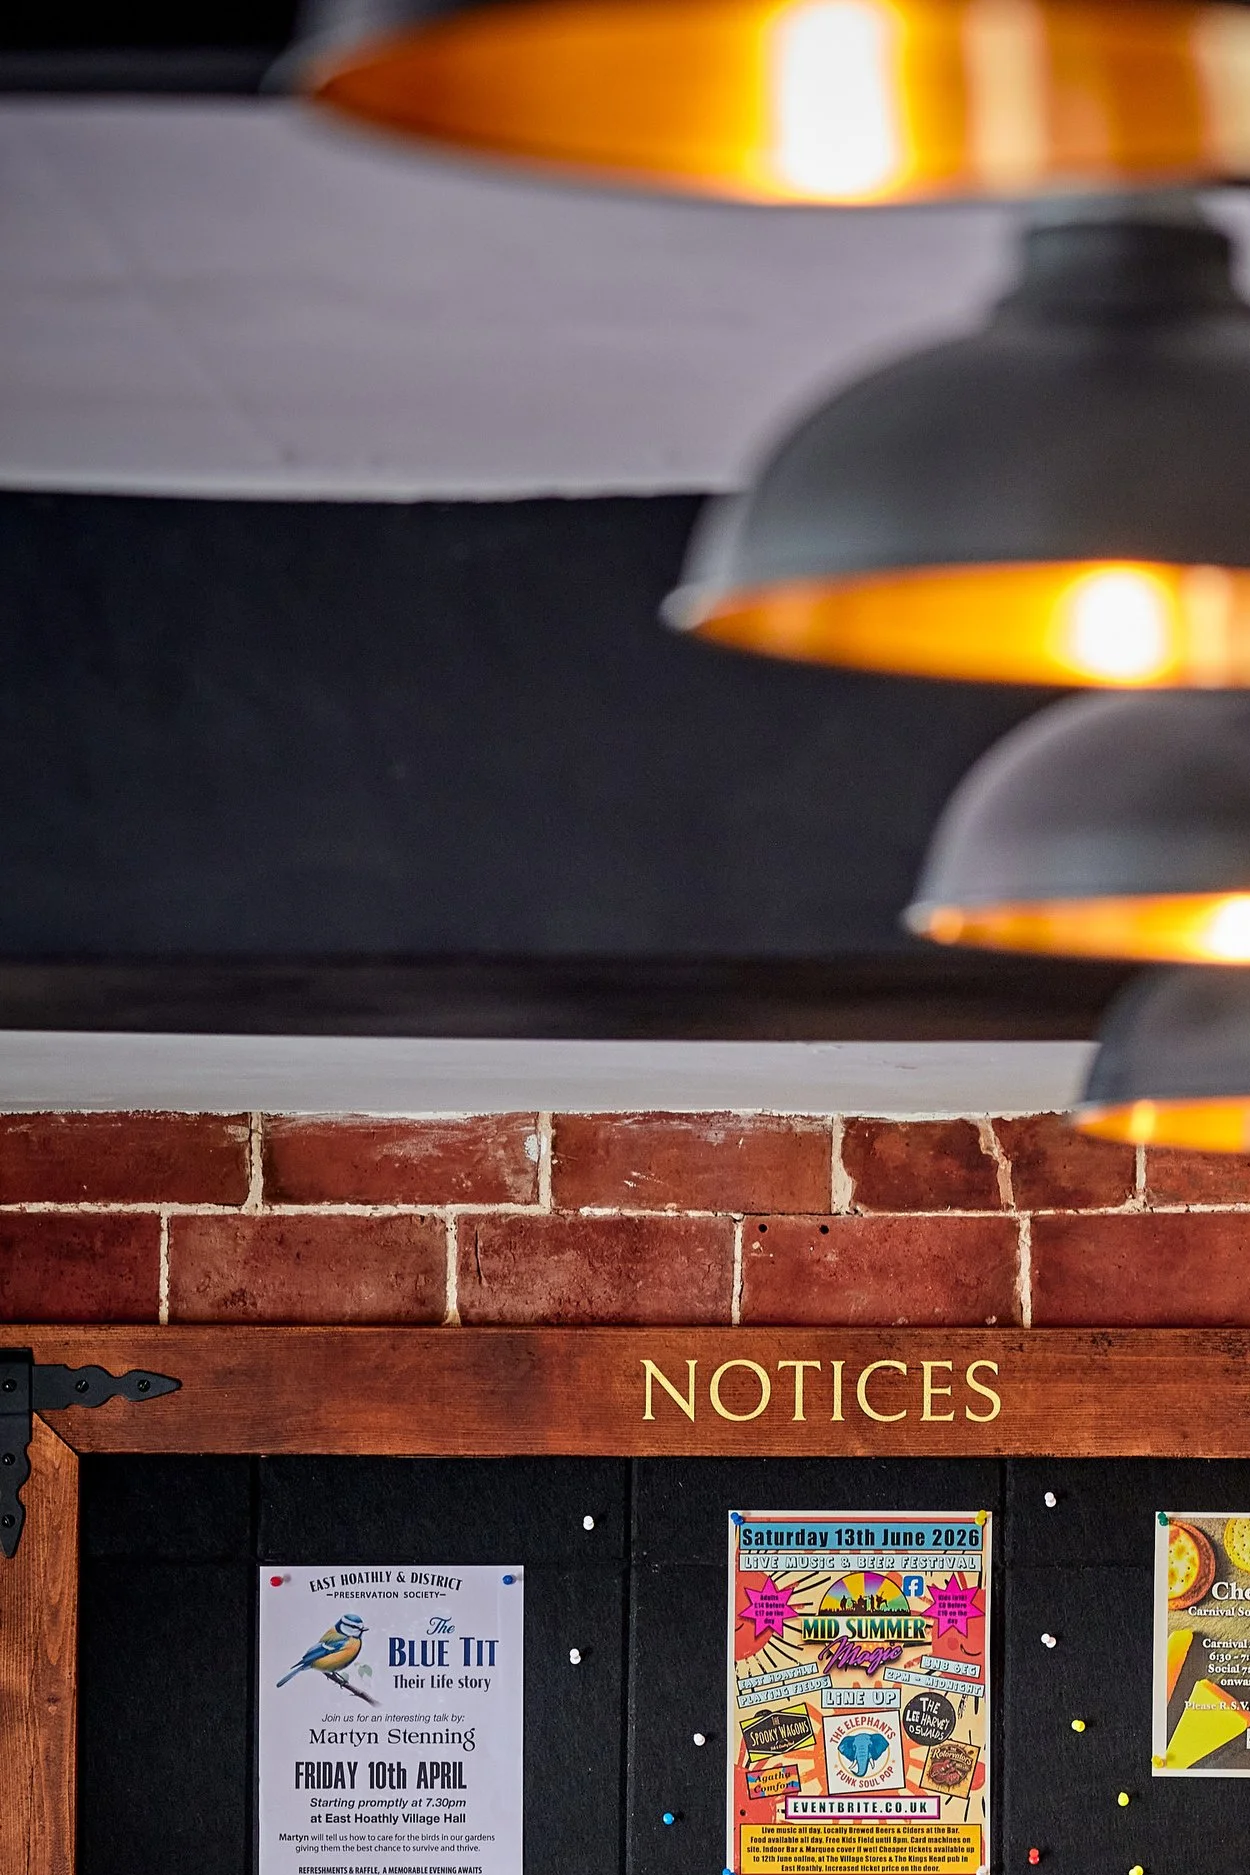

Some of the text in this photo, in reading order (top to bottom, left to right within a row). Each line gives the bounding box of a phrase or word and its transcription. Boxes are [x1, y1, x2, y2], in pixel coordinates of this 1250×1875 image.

[640, 1359, 1002, 1422] NOTICES
[743, 1529, 979, 1547] Saturday 13th June 2026
[841, 1556, 850, 1569] &
[857, 1556, 894, 1569] BEER
[310, 1571, 463, 1592] EAST HOATHLY & DISTRICT
[1188, 1606, 1234, 1617] Carnival
[427, 1616, 455, 1635] The
[802, 1618, 926, 1639] MID SUMMER
[1202, 1638, 1247, 1649] Carnival
[389, 1637, 499, 1667] BLUE TIT
[818, 1635, 903, 1675] Magic
[1209, 1652, 1231, 1663] 6:30
[1208, 1664, 1240, 1673] Social
[394, 1674, 491, 1692] Their Life story
[740, 1677, 764, 1689] EAST
[887, 1671, 911, 1682] 2PM
[872, 1691, 896, 1705] UP
[920, 1698, 940, 1714] THE
[1185, 1701, 1216, 1710] Please
[321, 1714, 341, 1722] Join
[356, 1713, 369, 1722] for
[385, 1714, 431, 1723] interesting
[433, 1713, 449, 1722] talk
[451, 1714, 465, 1724] by:
[772, 1716, 780, 1726] THE
[906, 1710, 950, 1730] LEE HARVEY
[750, 1727, 778, 1747] SPOOKY
[778, 1720, 809, 1739] WAGONS
[830, 1716, 896, 1744] THE ELEPHANTS
[909, 1725, 944, 1740] OSWALDS
[309, 1728, 475, 1751] Martyn Stenning
[295, 1761, 467, 1790] FRIDAY 10th APRIL
[755, 1772, 790, 1783] Agatha
[836, 1766, 894, 1788] FUNK SOUL POP
[754, 1780, 794, 1793] Comfort
[310, 1798, 466, 1809] Starting promptly at 7.30pm
[794, 1802, 927, 1814] EVENTBRITE.CO.UK
[310, 1813, 466, 1825] at East Hoathly Village Hall
[279, 1833, 309, 1843] Martyn
[395, 1833, 405, 1841] for
[464, 1834, 495, 1842] gardens
